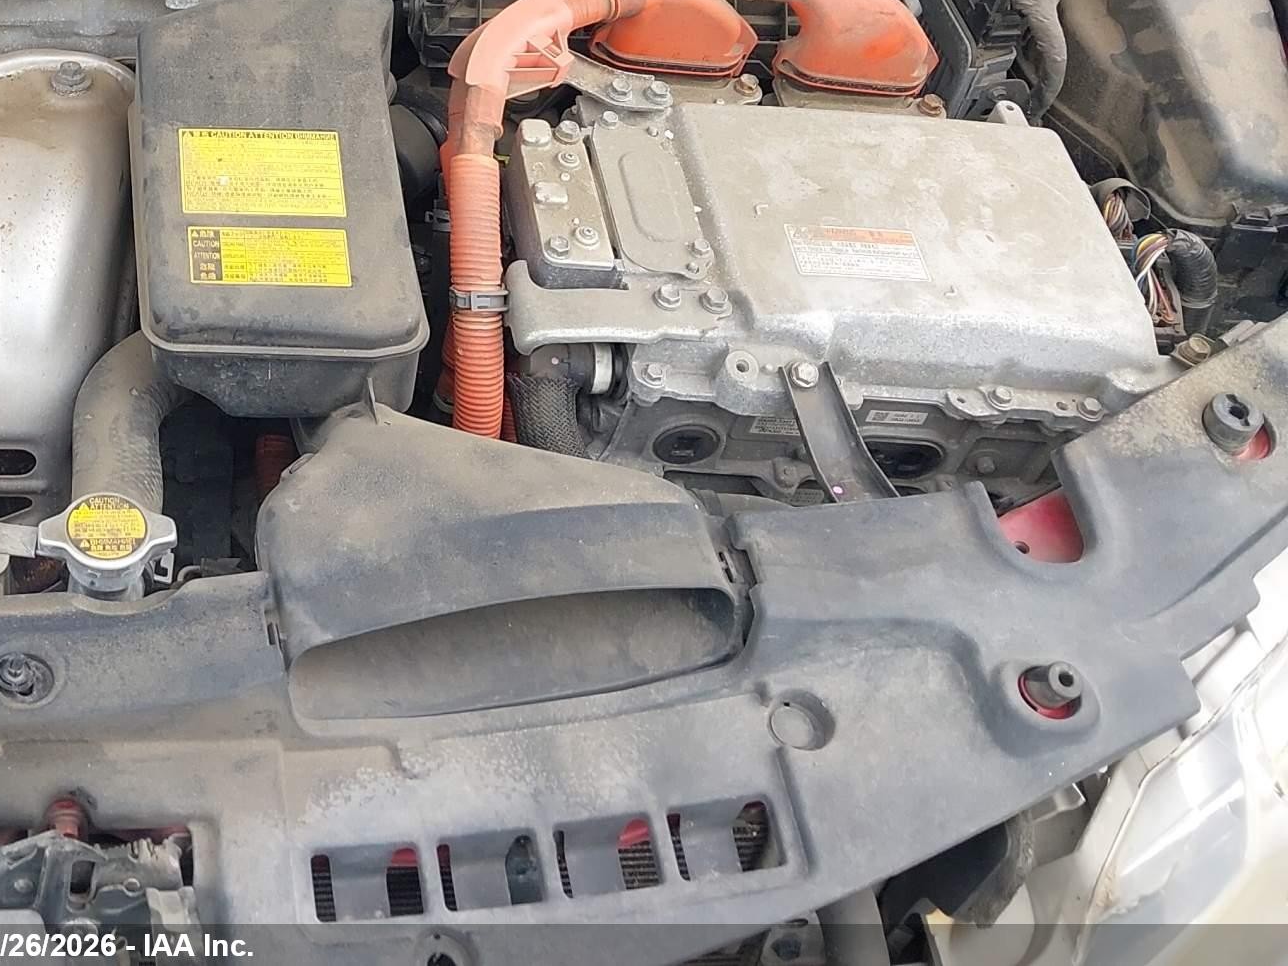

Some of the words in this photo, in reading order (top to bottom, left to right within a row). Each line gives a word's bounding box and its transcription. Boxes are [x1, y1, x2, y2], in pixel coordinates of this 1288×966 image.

[250, 131, 293, 139] ATTENTION
[193, 240, 220, 248] CAUTION
[193, 251, 220, 260] ATTENTION
